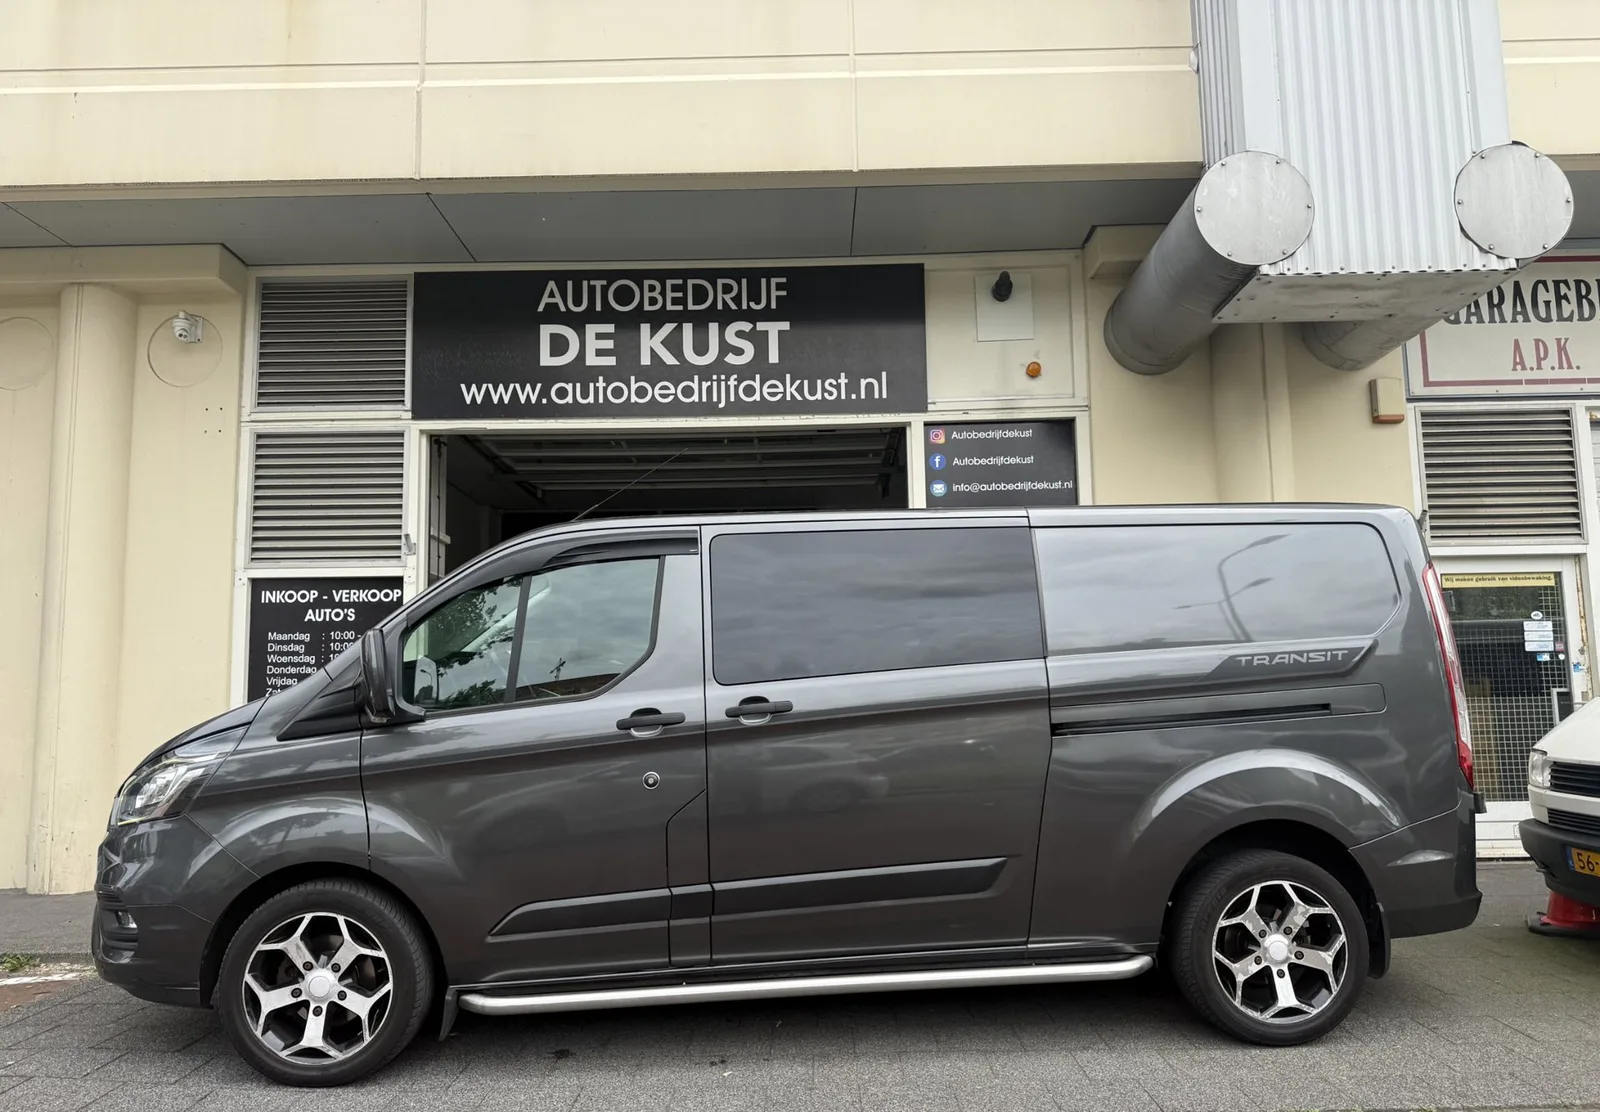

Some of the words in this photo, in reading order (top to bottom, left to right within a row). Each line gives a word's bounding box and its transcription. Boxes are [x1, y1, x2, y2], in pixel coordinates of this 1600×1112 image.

[537, 277, 787, 312] AUTOBEDRIJF
[1443, 278, 1600, 325] ARAGEB
[539, 323, 617, 366] DE
[640, 321, 790, 365] KUST
[1511, 337, 1581, 371] A.P.K.
[460, 371, 888, 408] www.autobedrijfdekust.nl
[951, 428, 1033, 440] Autobedrijfdekust
[952, 455, 1034, 467] Autobedrijfdekust
[952, 480, 1073, 493] info@autobedrijfdekust.nl
[261, 590, 318, 603] INKOOP
[332, 589, 402, 602] VERKOOP
[304, 608, 355, 621] AUTO'S
[268, 632, 310, 642] Maandag
[330, 631, 355, 640] 10:00
[267, 643, 305, 653] Dinsdag
[267, 654, 315, 664] Woensdag
[1235, 650, 1349, 667] TRANSIT
[266, 665, 317, 676] Donderdag
[266, 677, 298, 687] Vrijdag
